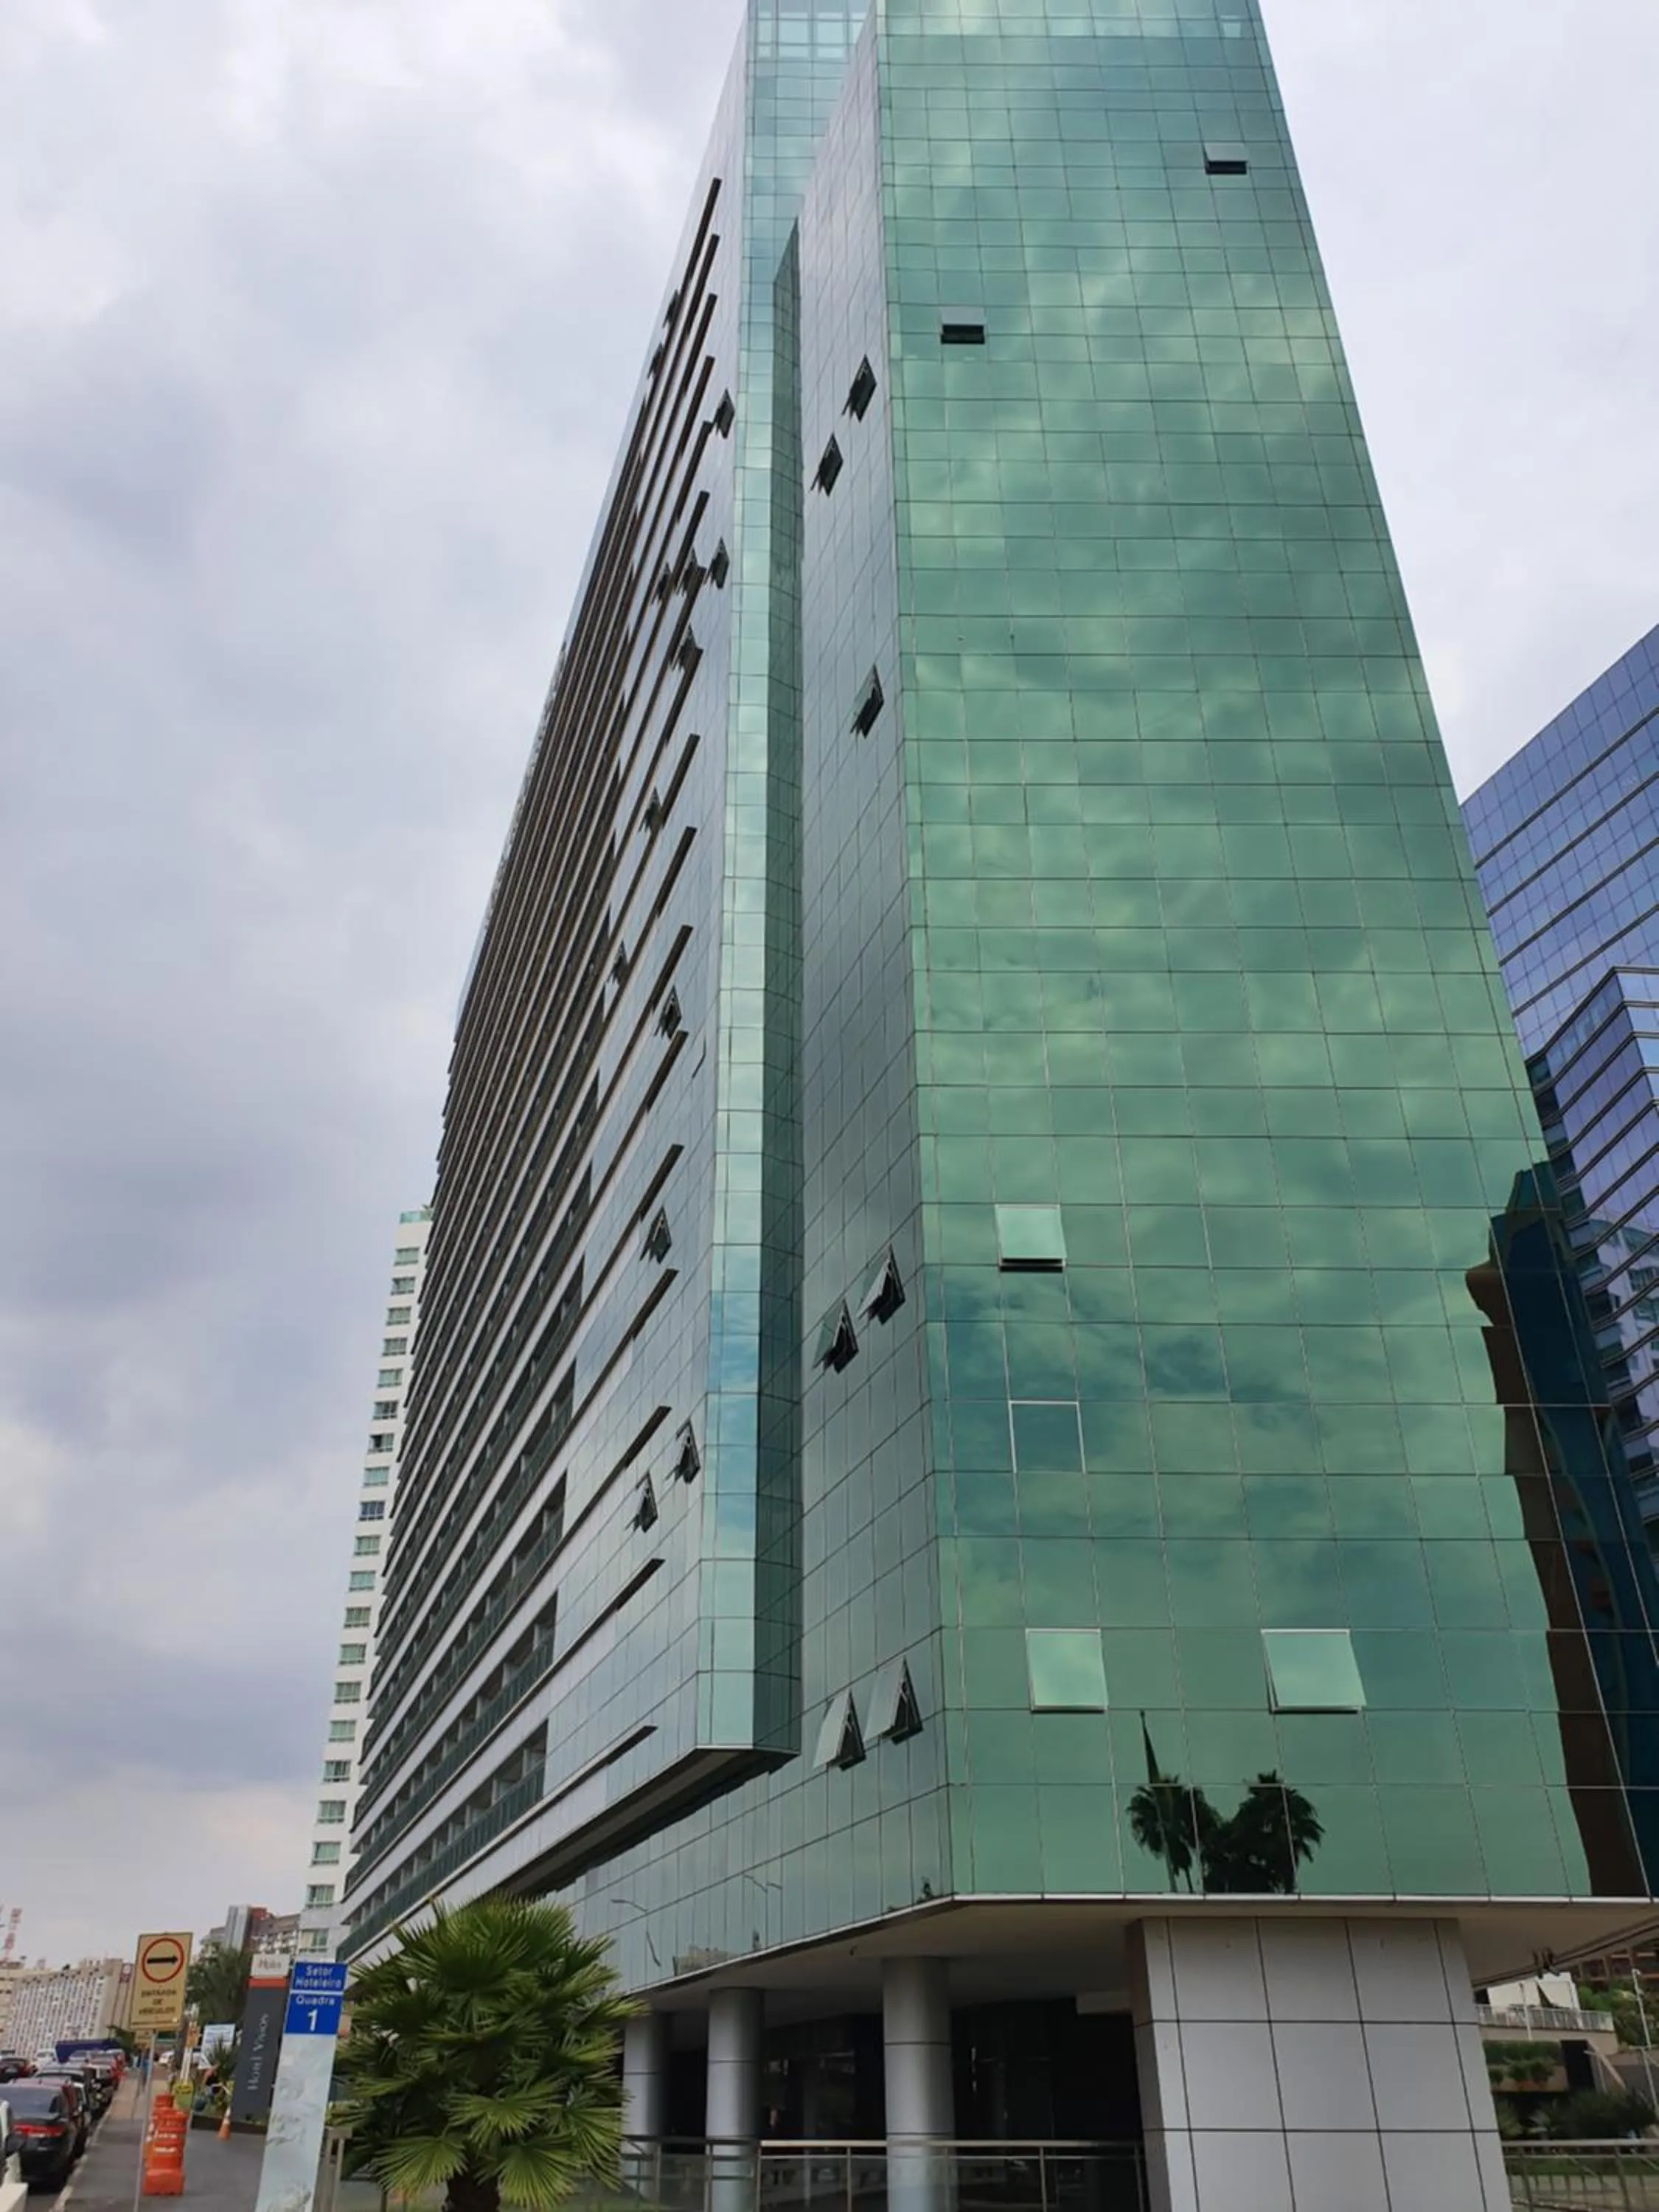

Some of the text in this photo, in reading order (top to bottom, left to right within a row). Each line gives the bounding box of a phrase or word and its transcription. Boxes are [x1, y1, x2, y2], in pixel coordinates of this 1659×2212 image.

[306, 1966, 333, 1976] Setor
[296, 1996, 335, 2006] Quadra
[307, 2008, 318, 2032] 1
